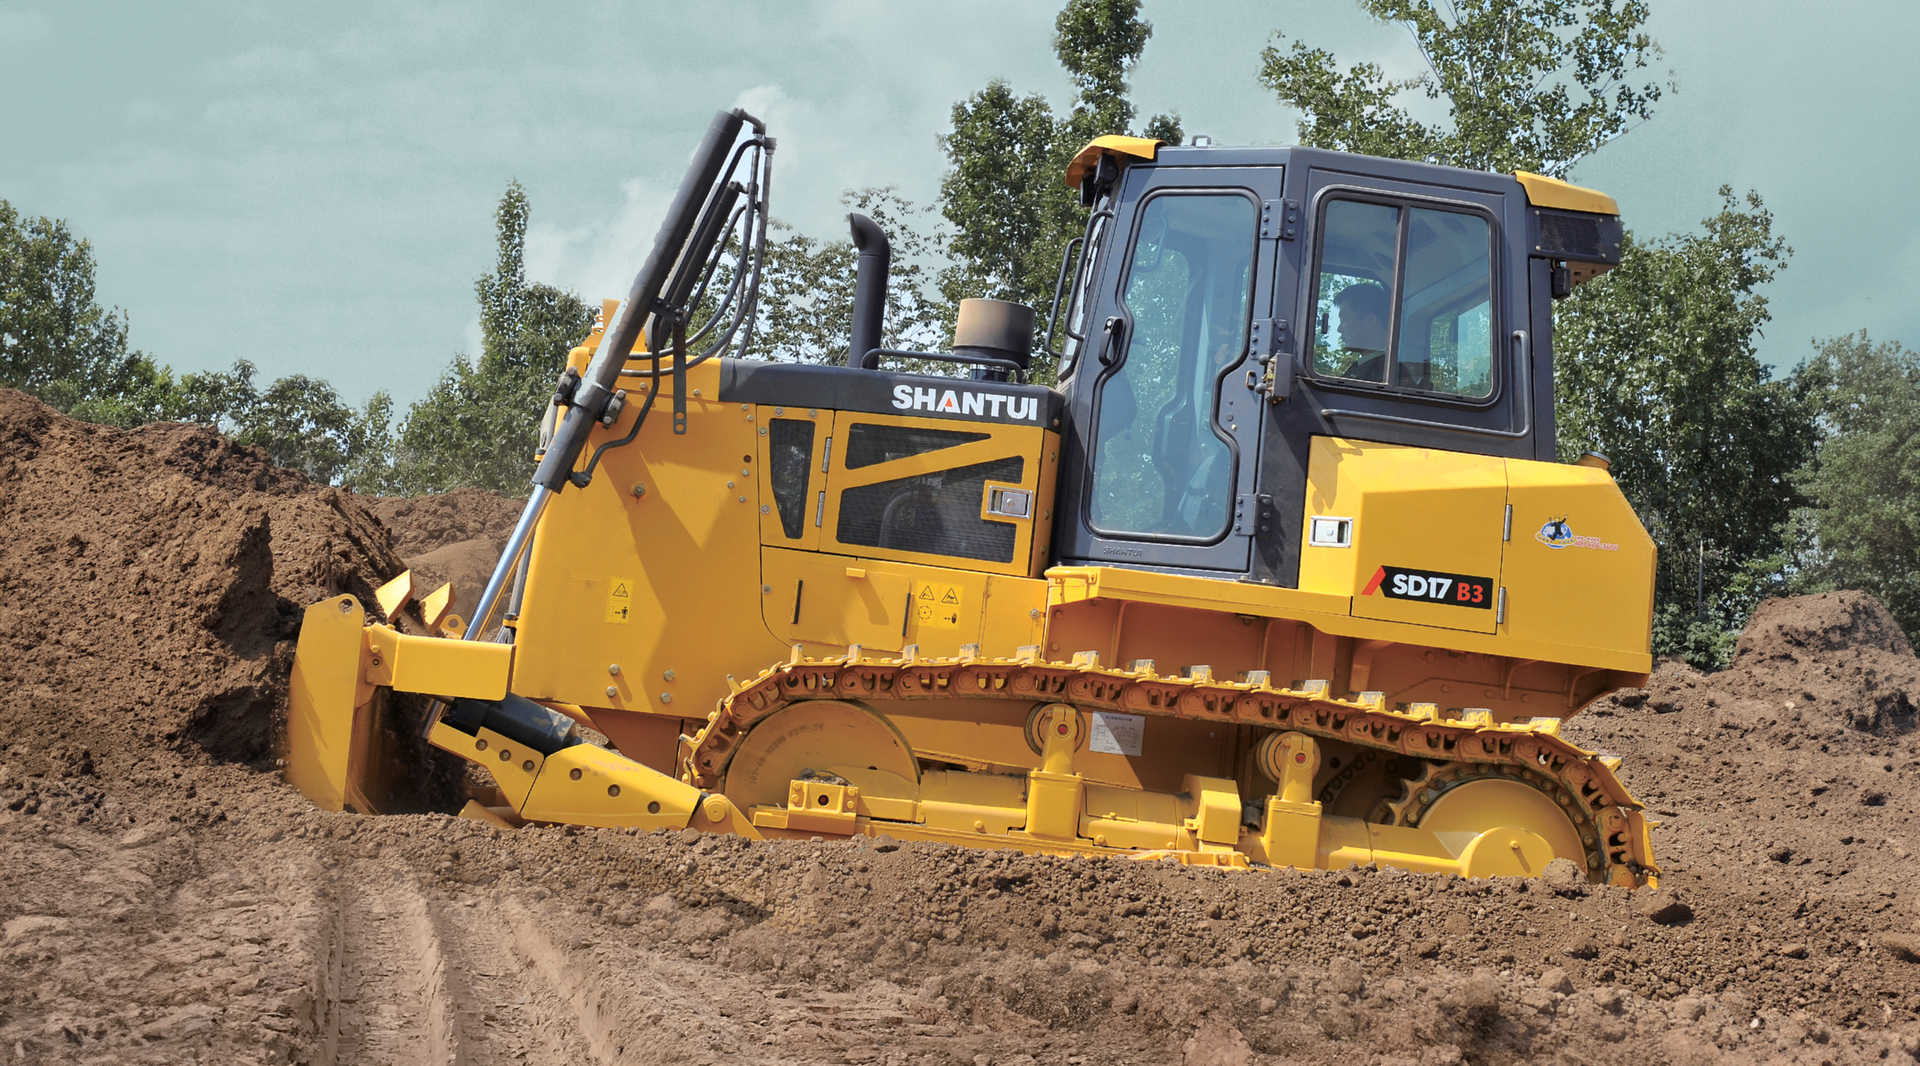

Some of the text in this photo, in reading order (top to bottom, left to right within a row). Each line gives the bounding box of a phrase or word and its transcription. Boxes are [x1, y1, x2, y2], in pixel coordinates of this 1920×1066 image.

[892, 385, 1038, 421] SHANTUI
[1103, 546, 1143, 557] SHANTUI
[1392, 574, 1484, 603] SD17 B3
